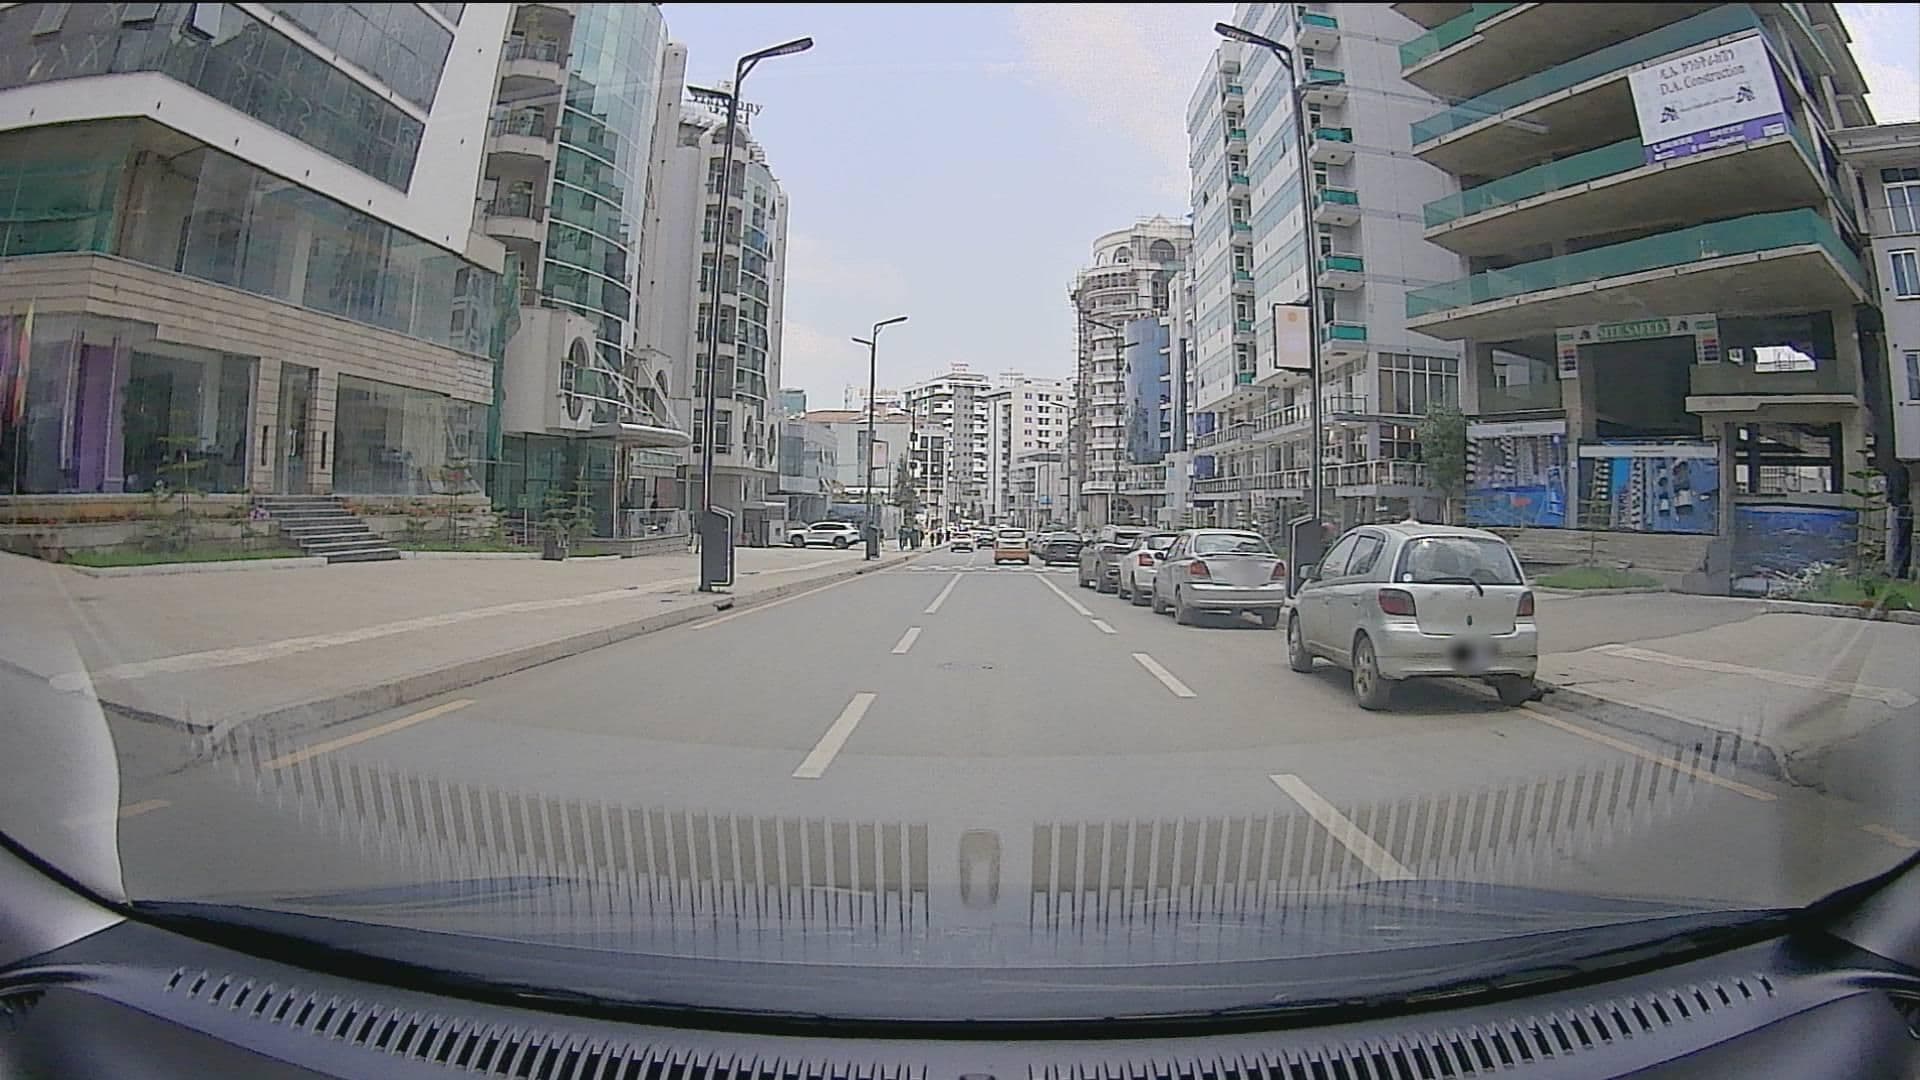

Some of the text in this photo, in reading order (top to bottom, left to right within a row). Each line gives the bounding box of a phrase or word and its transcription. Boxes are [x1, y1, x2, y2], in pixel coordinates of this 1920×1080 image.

[1684, 64, 1745, 89] Construction
[1598, 321, 1669, 339] SITE SAFETY
